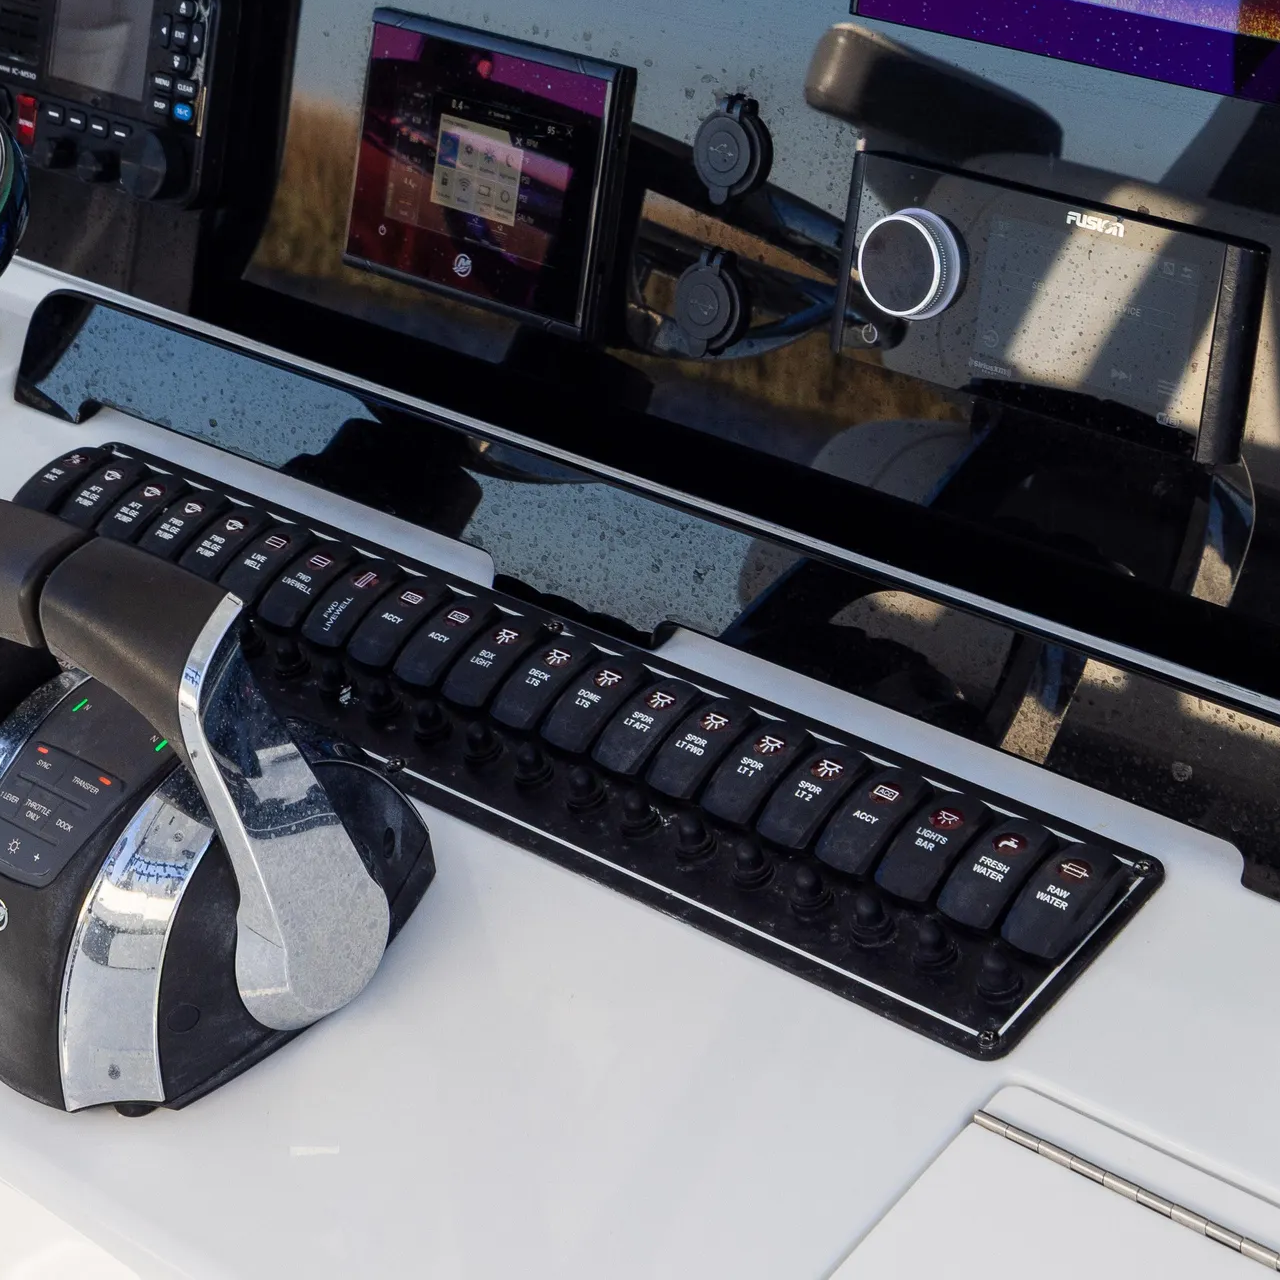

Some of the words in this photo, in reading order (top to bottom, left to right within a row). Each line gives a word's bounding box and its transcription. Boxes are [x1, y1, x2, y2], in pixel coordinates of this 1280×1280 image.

[174, 30, 186, 40] ENT
[154, 76, 170, 87] MENU
[177, 83, 194, 94] CLEAR
[153, 101, 166, 110] DISP
[1066, 210, 1125, 238] FUSION
[80, 490, 100, 502] BILGE
[89, 485, 104, 494] AFT
[75, 496, 94, 507] PUMP
[128, 501, 144, 510] AFT
[114, 512, 133, 524] PUMP
[120, 506, 140, 518] BILGE
[160, 522, 181, 535] BILGE
[168, 517, 184, 527] FWD
[154, 529, 174, 541] PUMP
[209, 534, 226, 545] FWD
[201, 539, 222, 552] BILGE
[195, 547, 216, 558] PUMP
[251, 552, 268, 563] LIVE
[243, 558, 261, 571] WELL
[295, 571, 312, 583] FWD
[281, 576, 313, 595] LIVEWELL
[322, 600, 339, 619] FWD
[323, 596, 355, 632] LIVEWELL
[381, 611, 404, 625] ACCY
[428, 631, 451, 644] ACCY
[478, 649, 497, 661] BOX
[470, 655, 494, 669] LIGHT
[525, 675, 541, 688] LTS
[528, 668, 551, 682] DECK
[577, 688, 602, 704] DOME
[575, 697, 592, 709] LTS
[631, 711, 655, 725] SPDR
[623, 717, 637, 728] LT
[635, 721, 651, 733] AFT
[684, 733, 708, 748] SPDR
[675, 739, 687, 751] LT
[686, 743, 706, 757] FWD
[36, 758, 52, 771] SYNC
[740, 756, 765, 772] SPDR
[736, 764, 749, 776] LT
[748, 768, 755, 778] 1
[71, 775, 100, 795] TRANSFER
[798, 779, 823, 796] SPDR
[3, 792, 20, 804] LEVER
[794, 788, 807, 800] LT
[805, 793, 813, 803] 2
[25, 798, 52, 817] THROTTLE
[25, 810, 41, 822] ONLY
[852, 809, 879, 825] ACCY
[55, 818, 74, 833] DOCK
[915, 826, 949, 845] LIGHTS
[914, 837, 936, 852] BAR
[978, 855, 1011, 875] FRESH
[972, 863, 1005, 883] WATER
[1046, 884, 1071, 899] RAW
[1036, 891, 1069, 911] WATER
